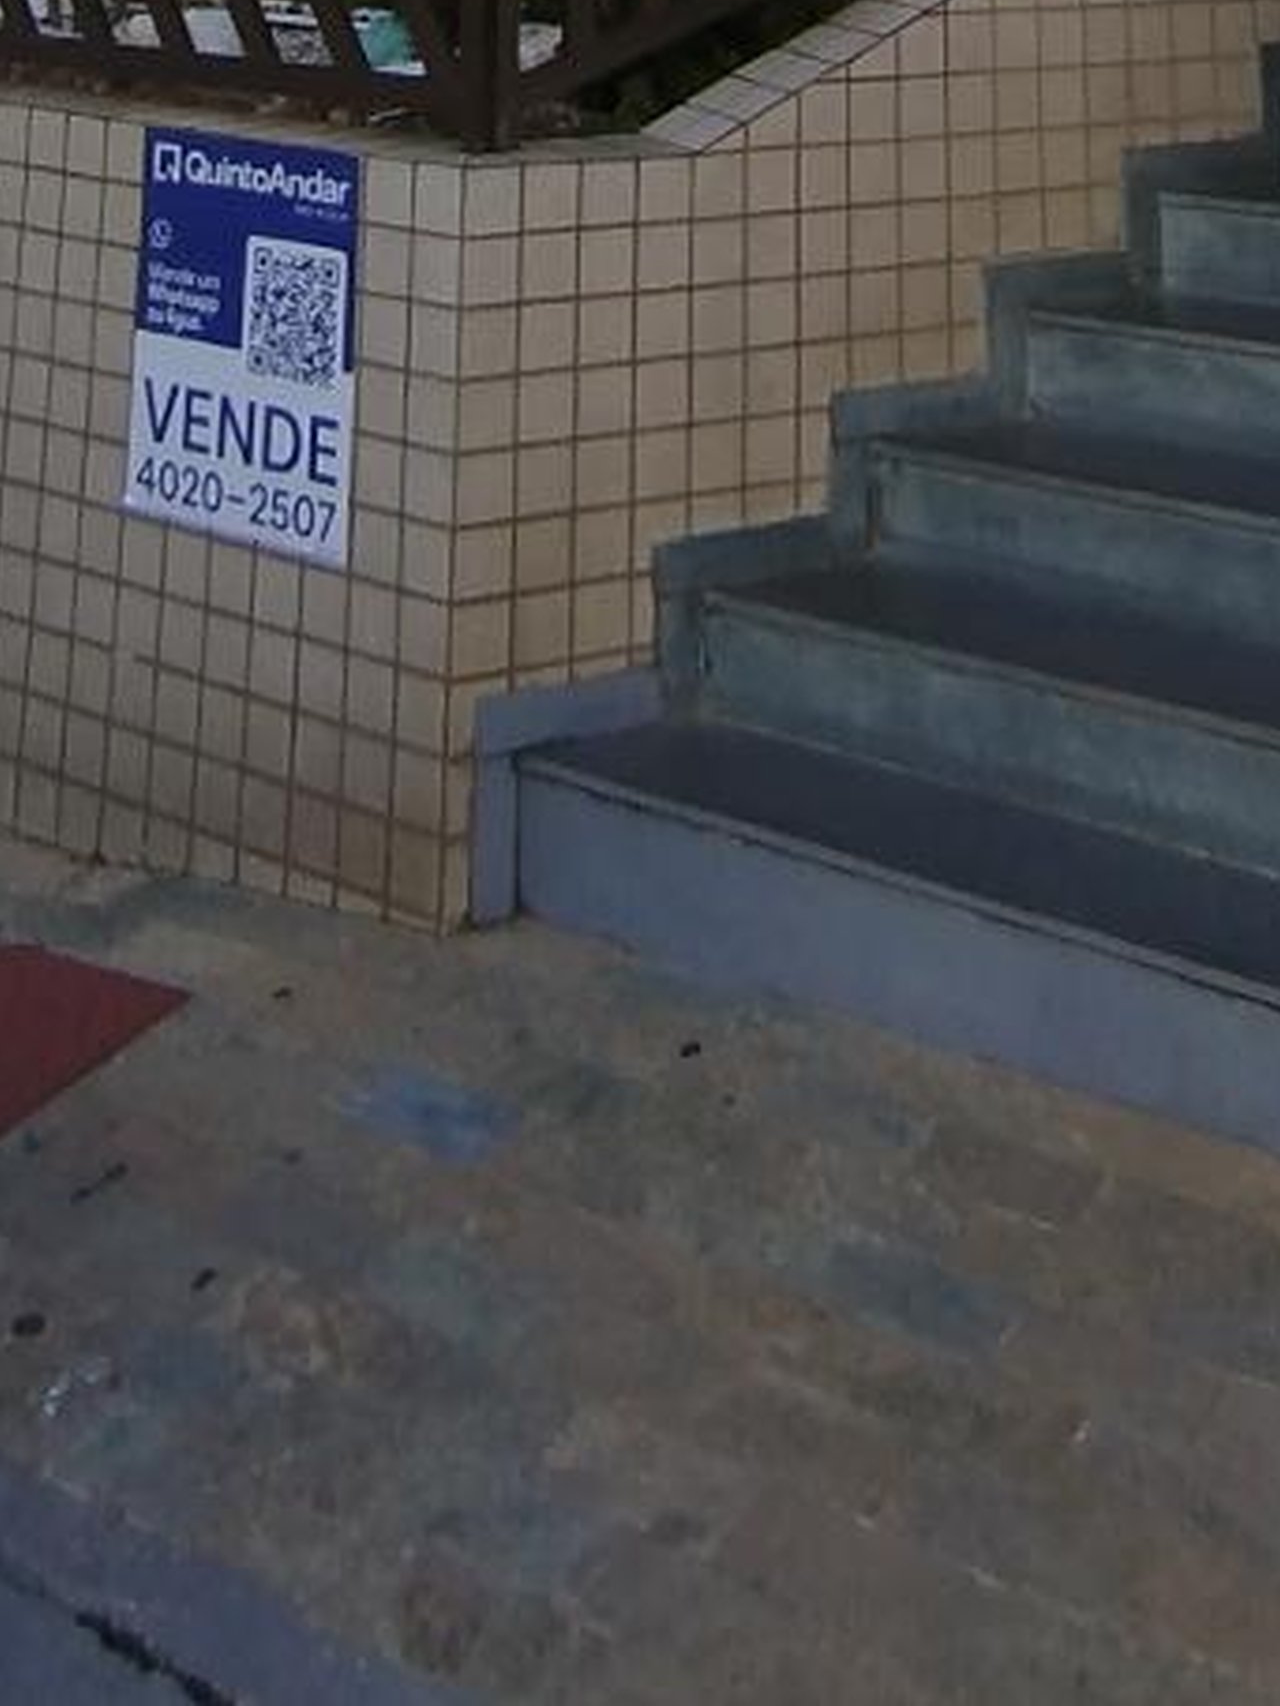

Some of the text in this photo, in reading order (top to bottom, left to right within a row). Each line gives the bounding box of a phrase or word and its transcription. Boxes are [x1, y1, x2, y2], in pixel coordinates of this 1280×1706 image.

[185, 150, 352, 207] QuintoAndar
[144, 377, 339, 488] VENDE
[136, 456, 337, 543] 4020-2507
